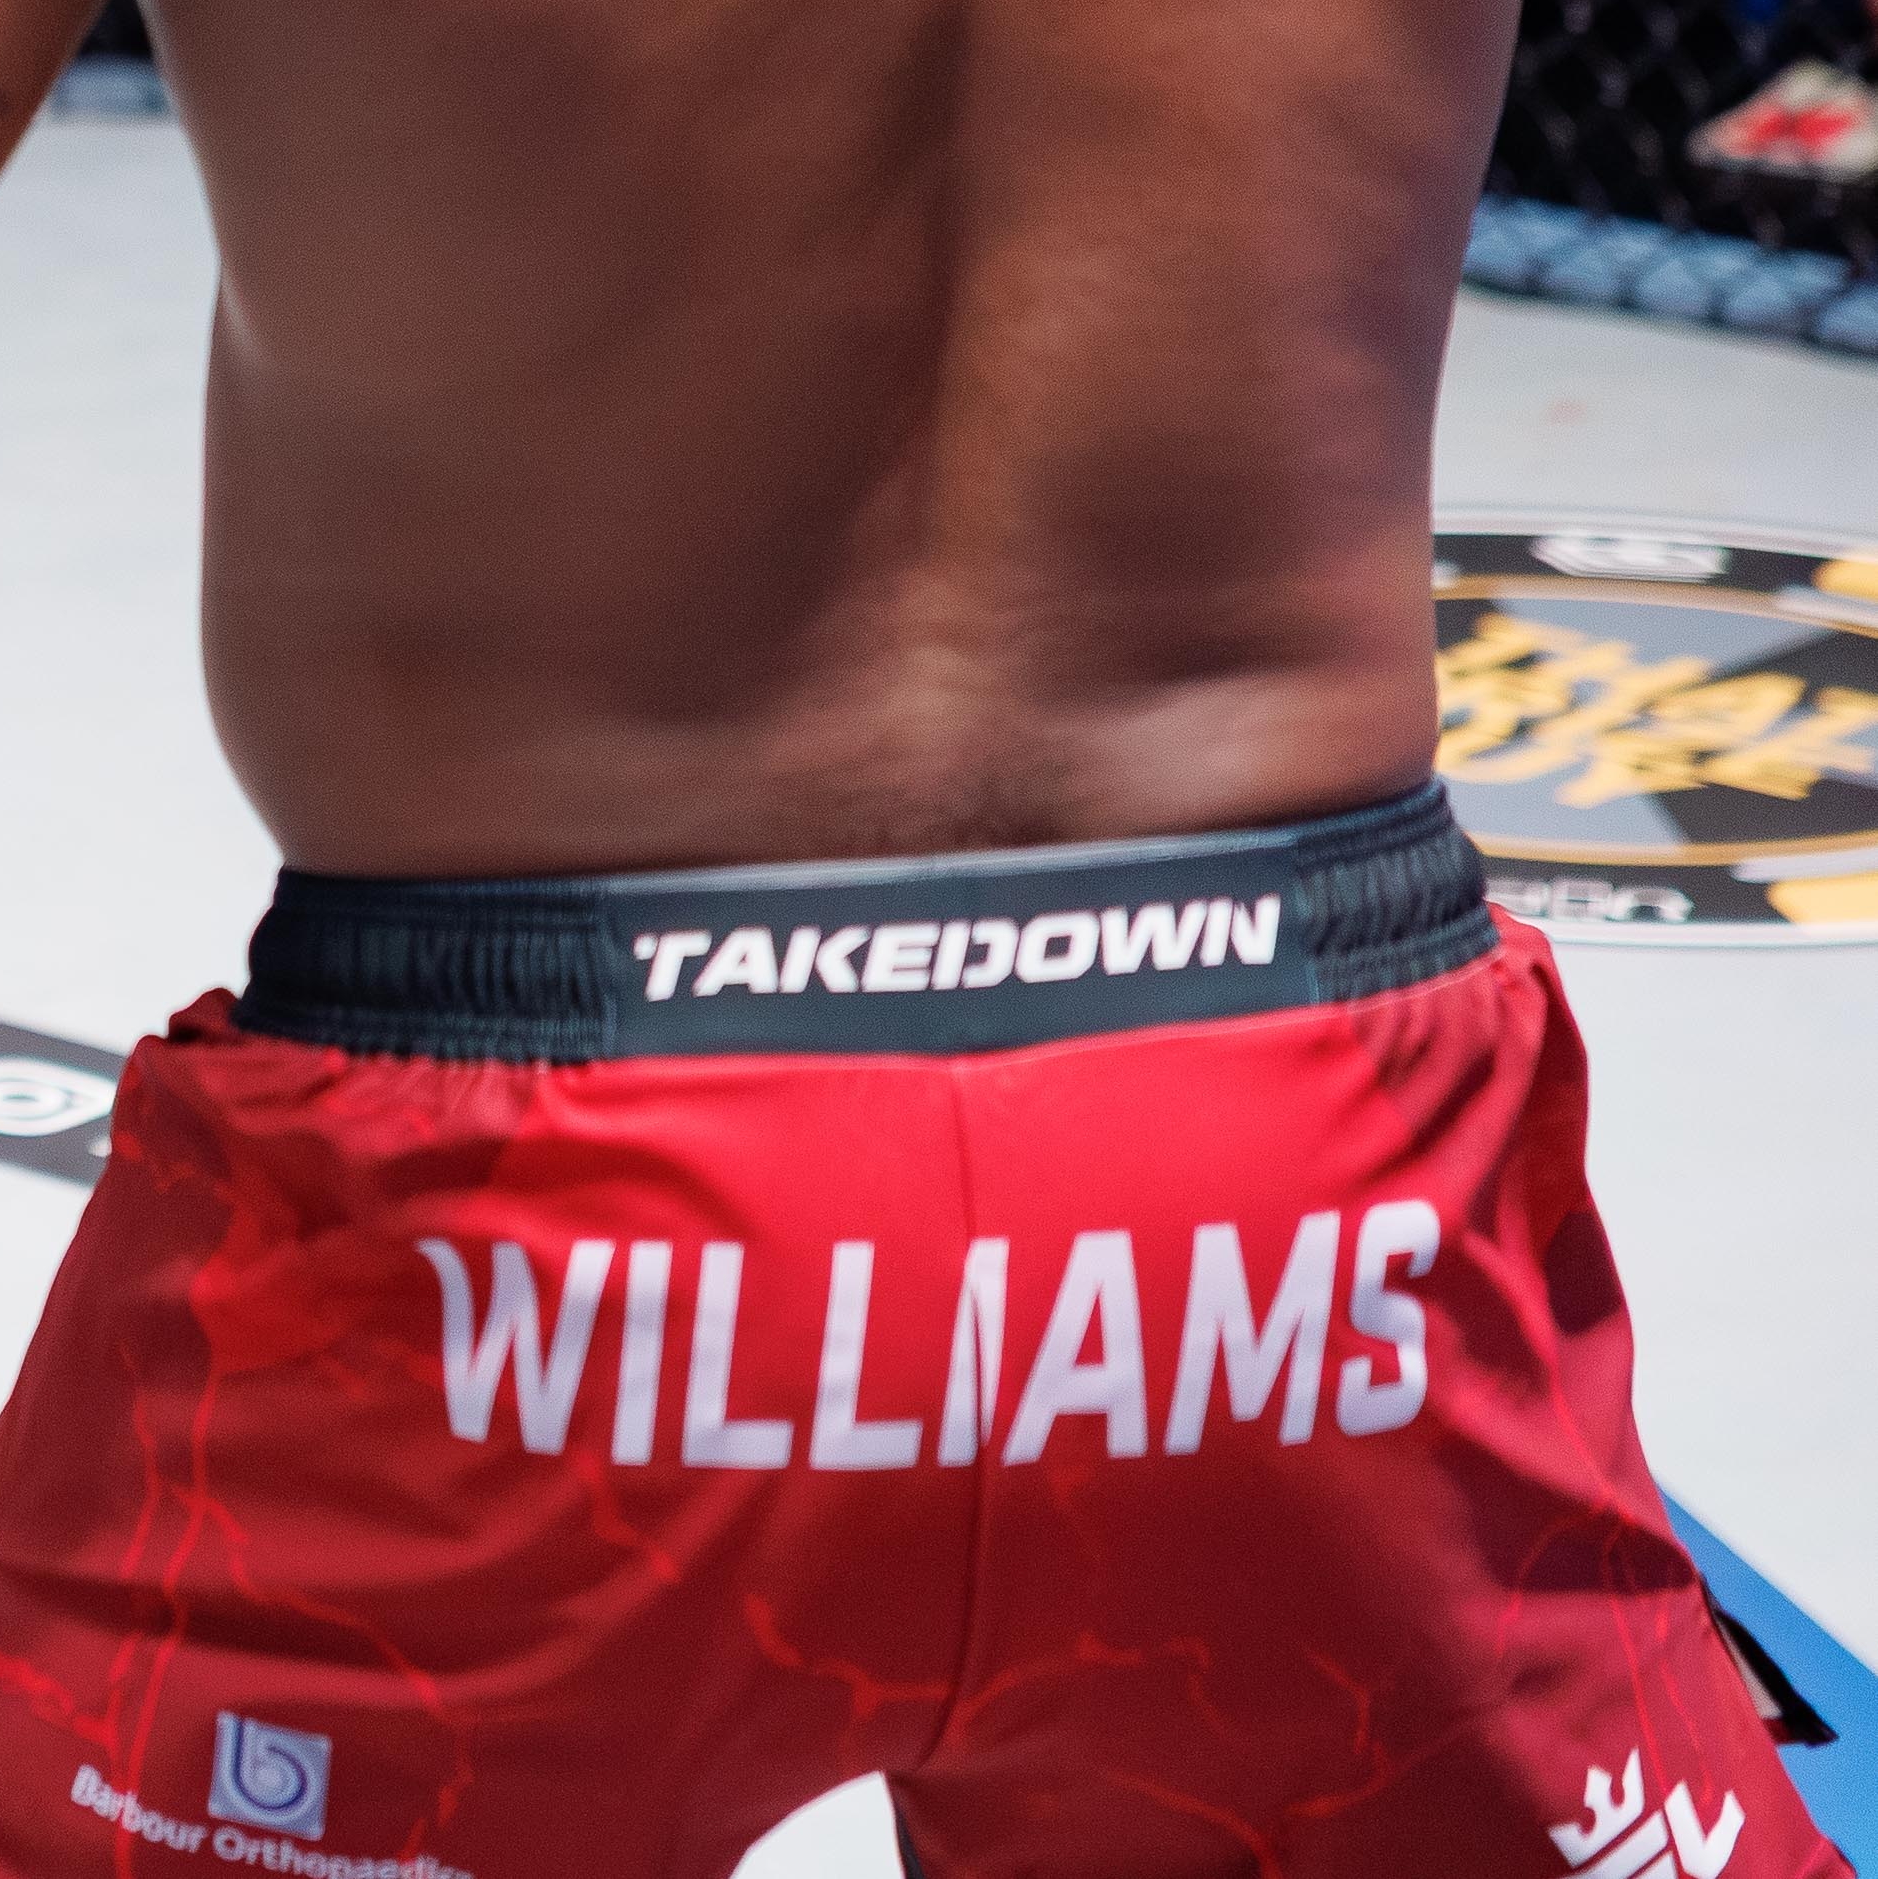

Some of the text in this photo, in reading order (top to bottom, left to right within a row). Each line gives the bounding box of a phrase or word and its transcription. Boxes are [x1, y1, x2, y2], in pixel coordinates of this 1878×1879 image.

[633, 895, 1282, 1002] TAKEDOWN
[414, 1198, 1442, 1472] WILLIAMS
[69, 1764, 209, 1855] Barbour
